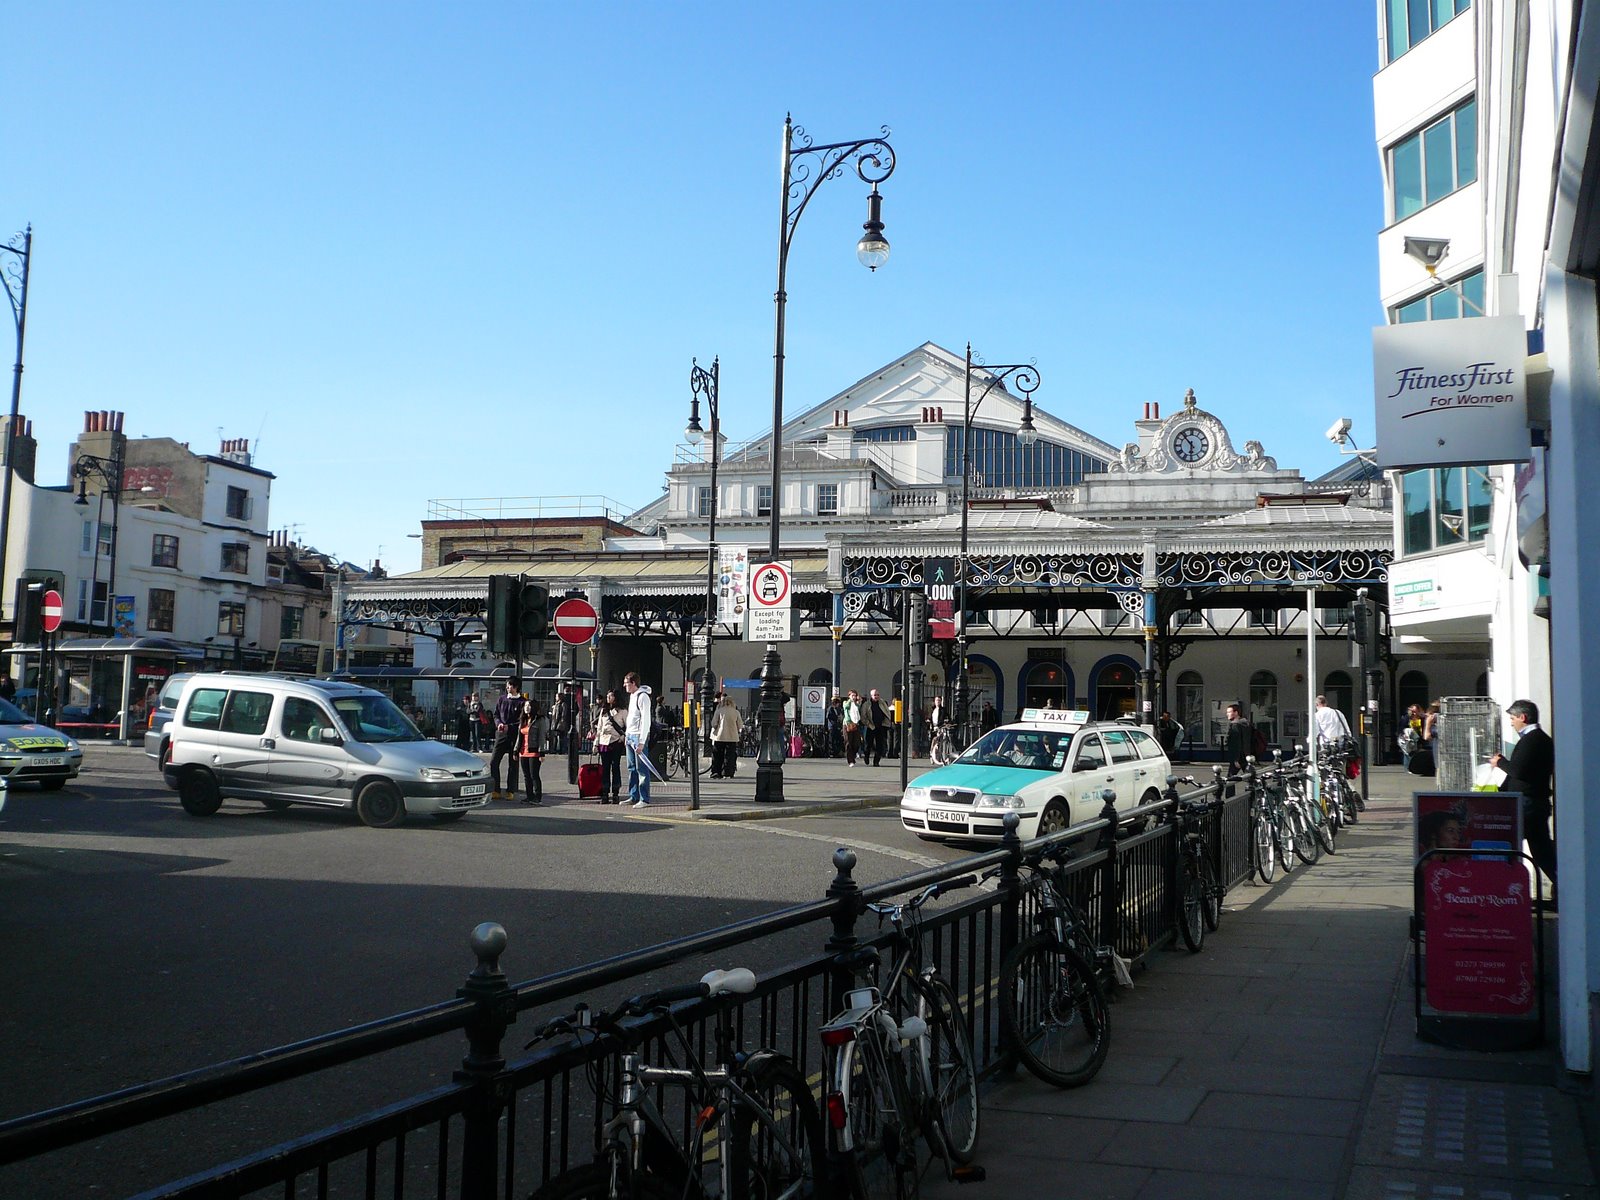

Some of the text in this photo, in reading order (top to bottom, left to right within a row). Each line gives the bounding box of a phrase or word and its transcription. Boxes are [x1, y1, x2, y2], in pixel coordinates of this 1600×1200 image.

[1430, 394, 1514, 406] For Women
[759, 617, 780, 625] loading
[480, 651, 487, 660] &
[1042, 713, 1068, 721] TAXI
[930, 811, 949, 820] HX54
[1487, 894, 1518, 907] Room
